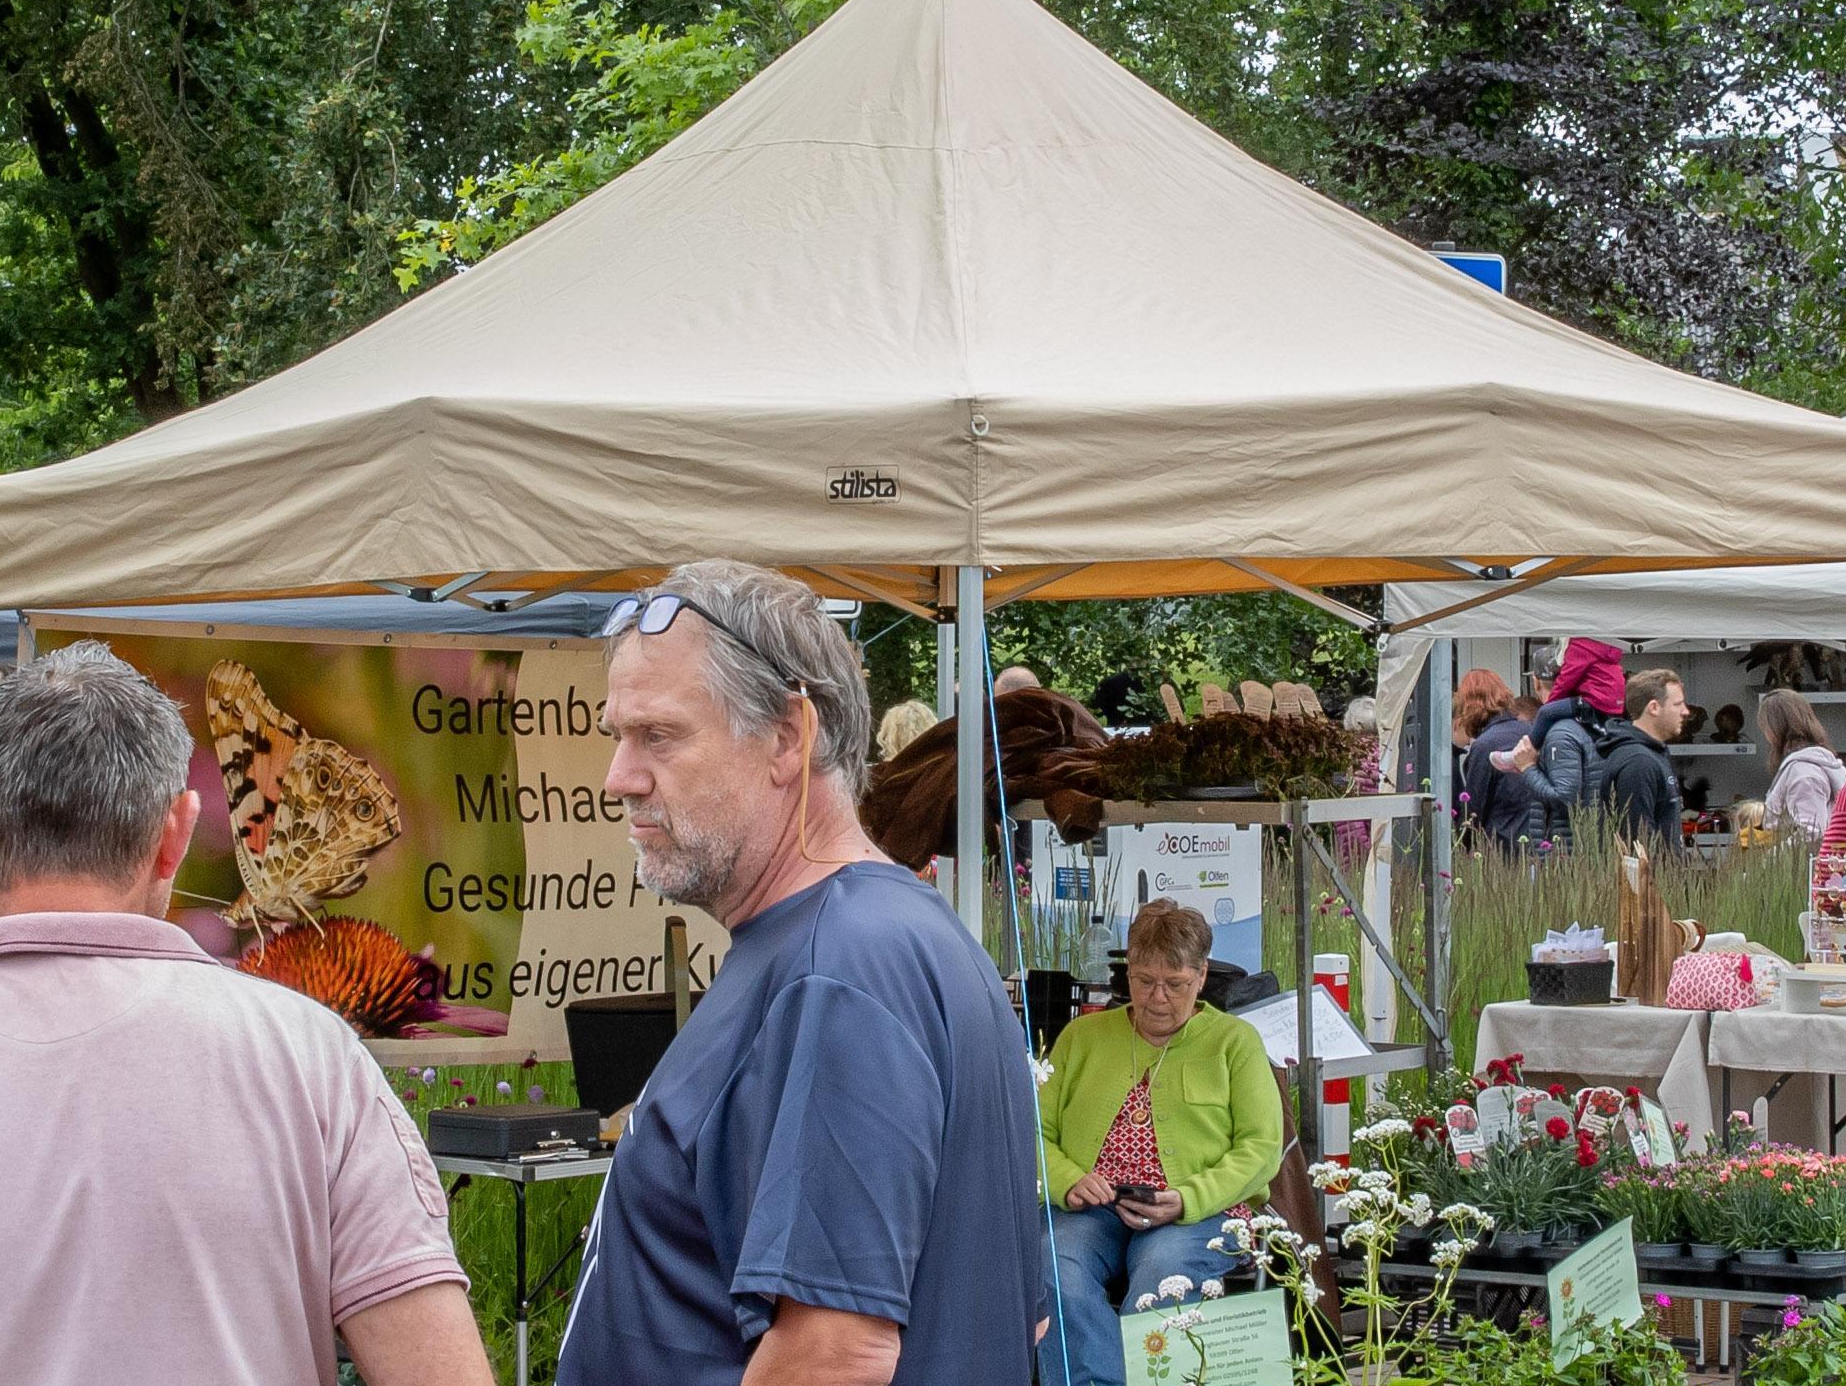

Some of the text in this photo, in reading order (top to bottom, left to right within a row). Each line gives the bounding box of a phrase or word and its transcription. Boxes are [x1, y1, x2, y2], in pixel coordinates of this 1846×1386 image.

[829, 470, 896, 499] stilista
[423, 859, 616, 912] Gesunde
[1208, 871, 1229, 881] Olfen
[414, 960, 495, 1001] aus
[509, 948, 662, 1009] eigener
